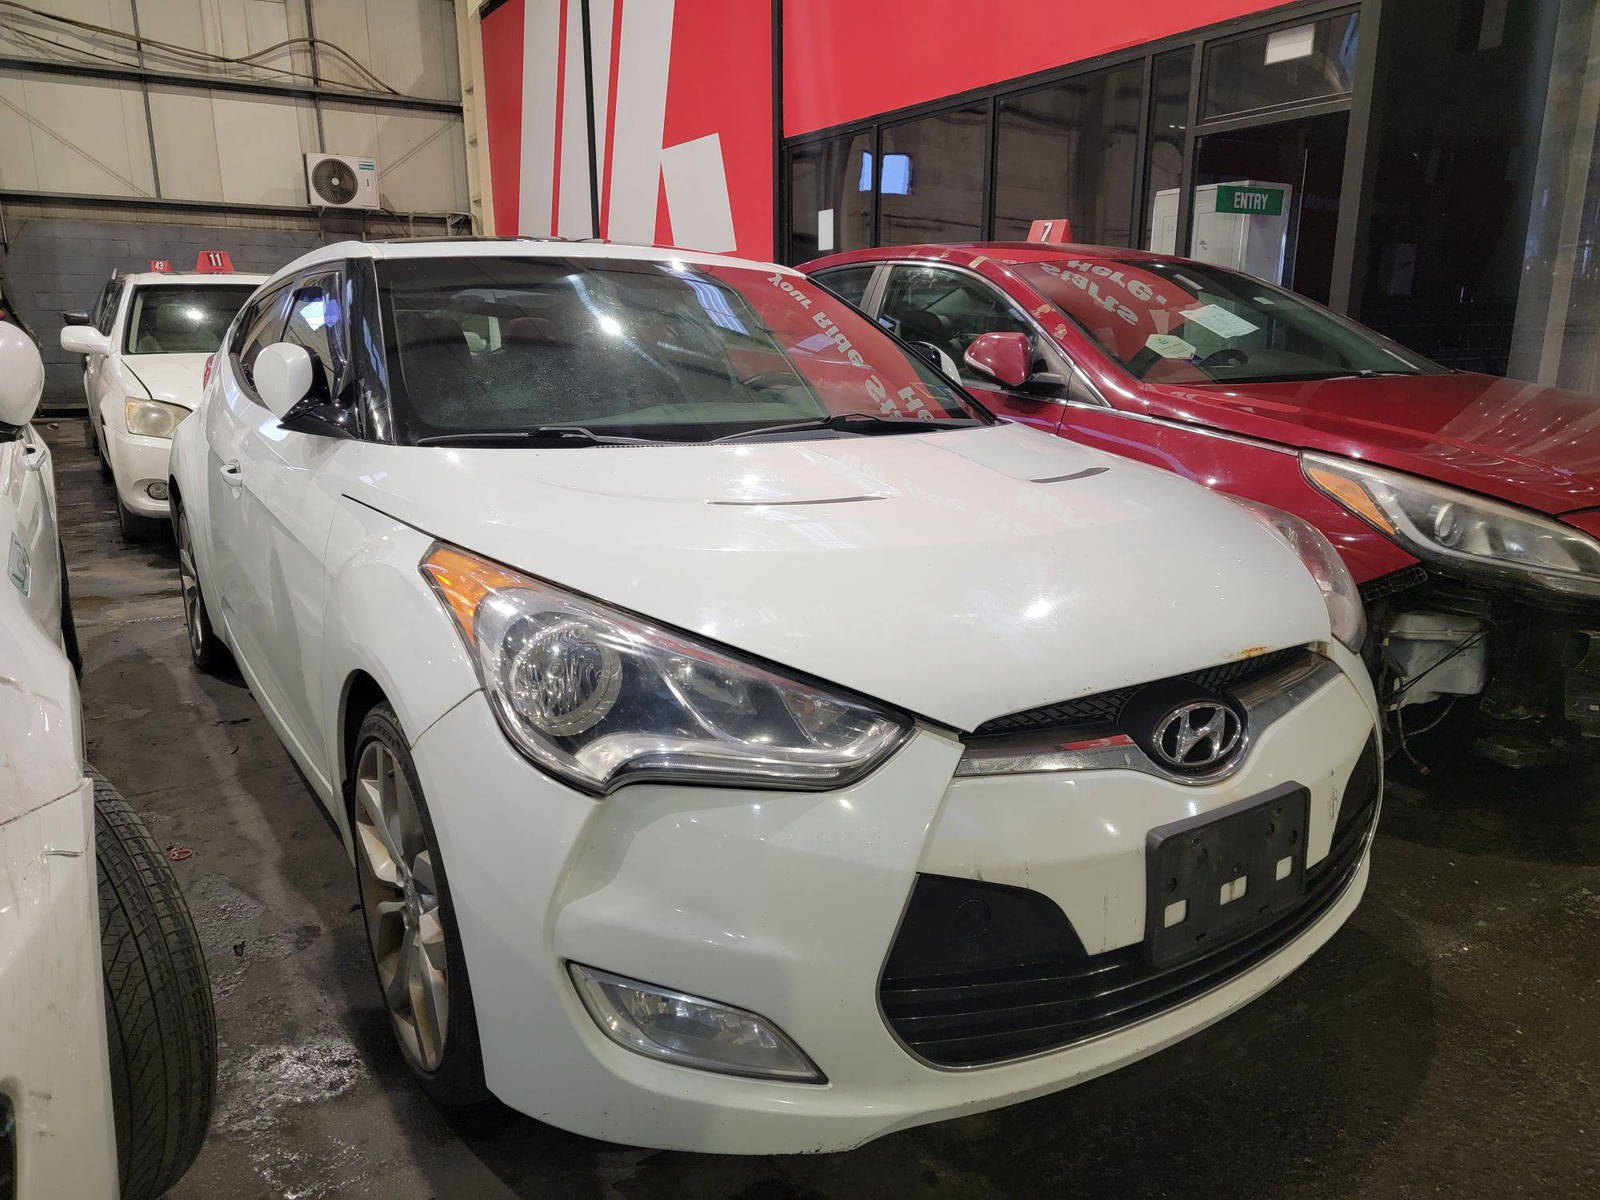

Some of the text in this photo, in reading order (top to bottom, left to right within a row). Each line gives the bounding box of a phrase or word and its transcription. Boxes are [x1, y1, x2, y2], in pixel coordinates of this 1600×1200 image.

[1232, 190, 1269, 210] ENTRY
[1040, 222, 1052, 242] 7
[209, 252, 223, 267] 11
